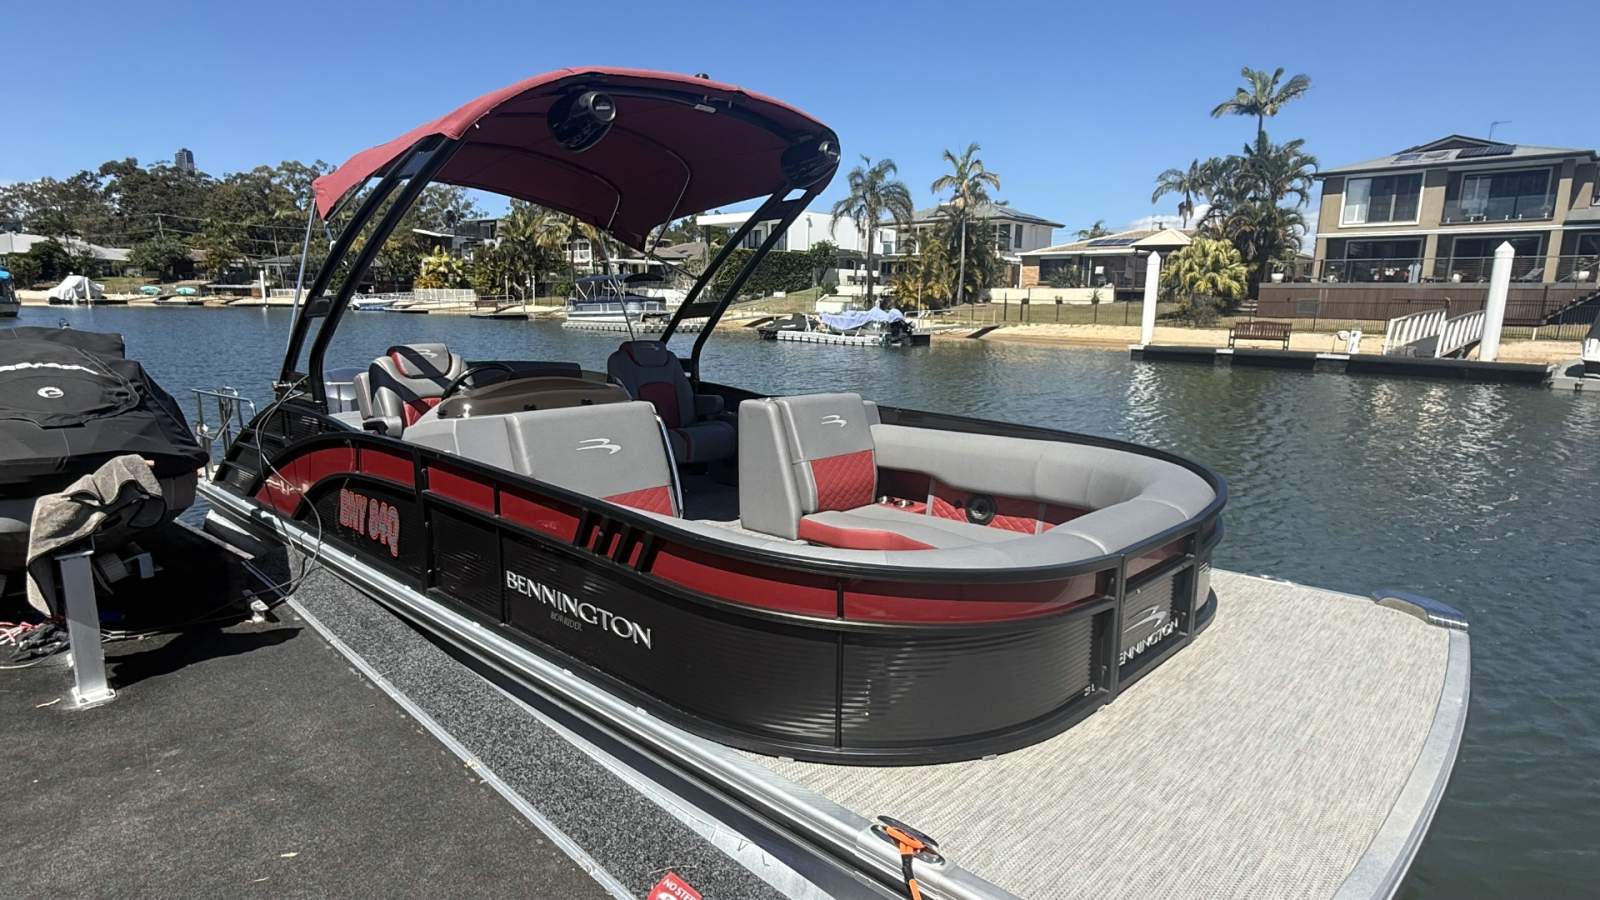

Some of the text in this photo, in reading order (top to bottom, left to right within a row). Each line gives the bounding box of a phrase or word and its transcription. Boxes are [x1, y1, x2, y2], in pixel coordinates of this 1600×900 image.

[506, 570, 651, 649] BENNINGTON
[1119, 617, 1178, 666] ENNINGTON
[663, 879, 678, 891] NO
